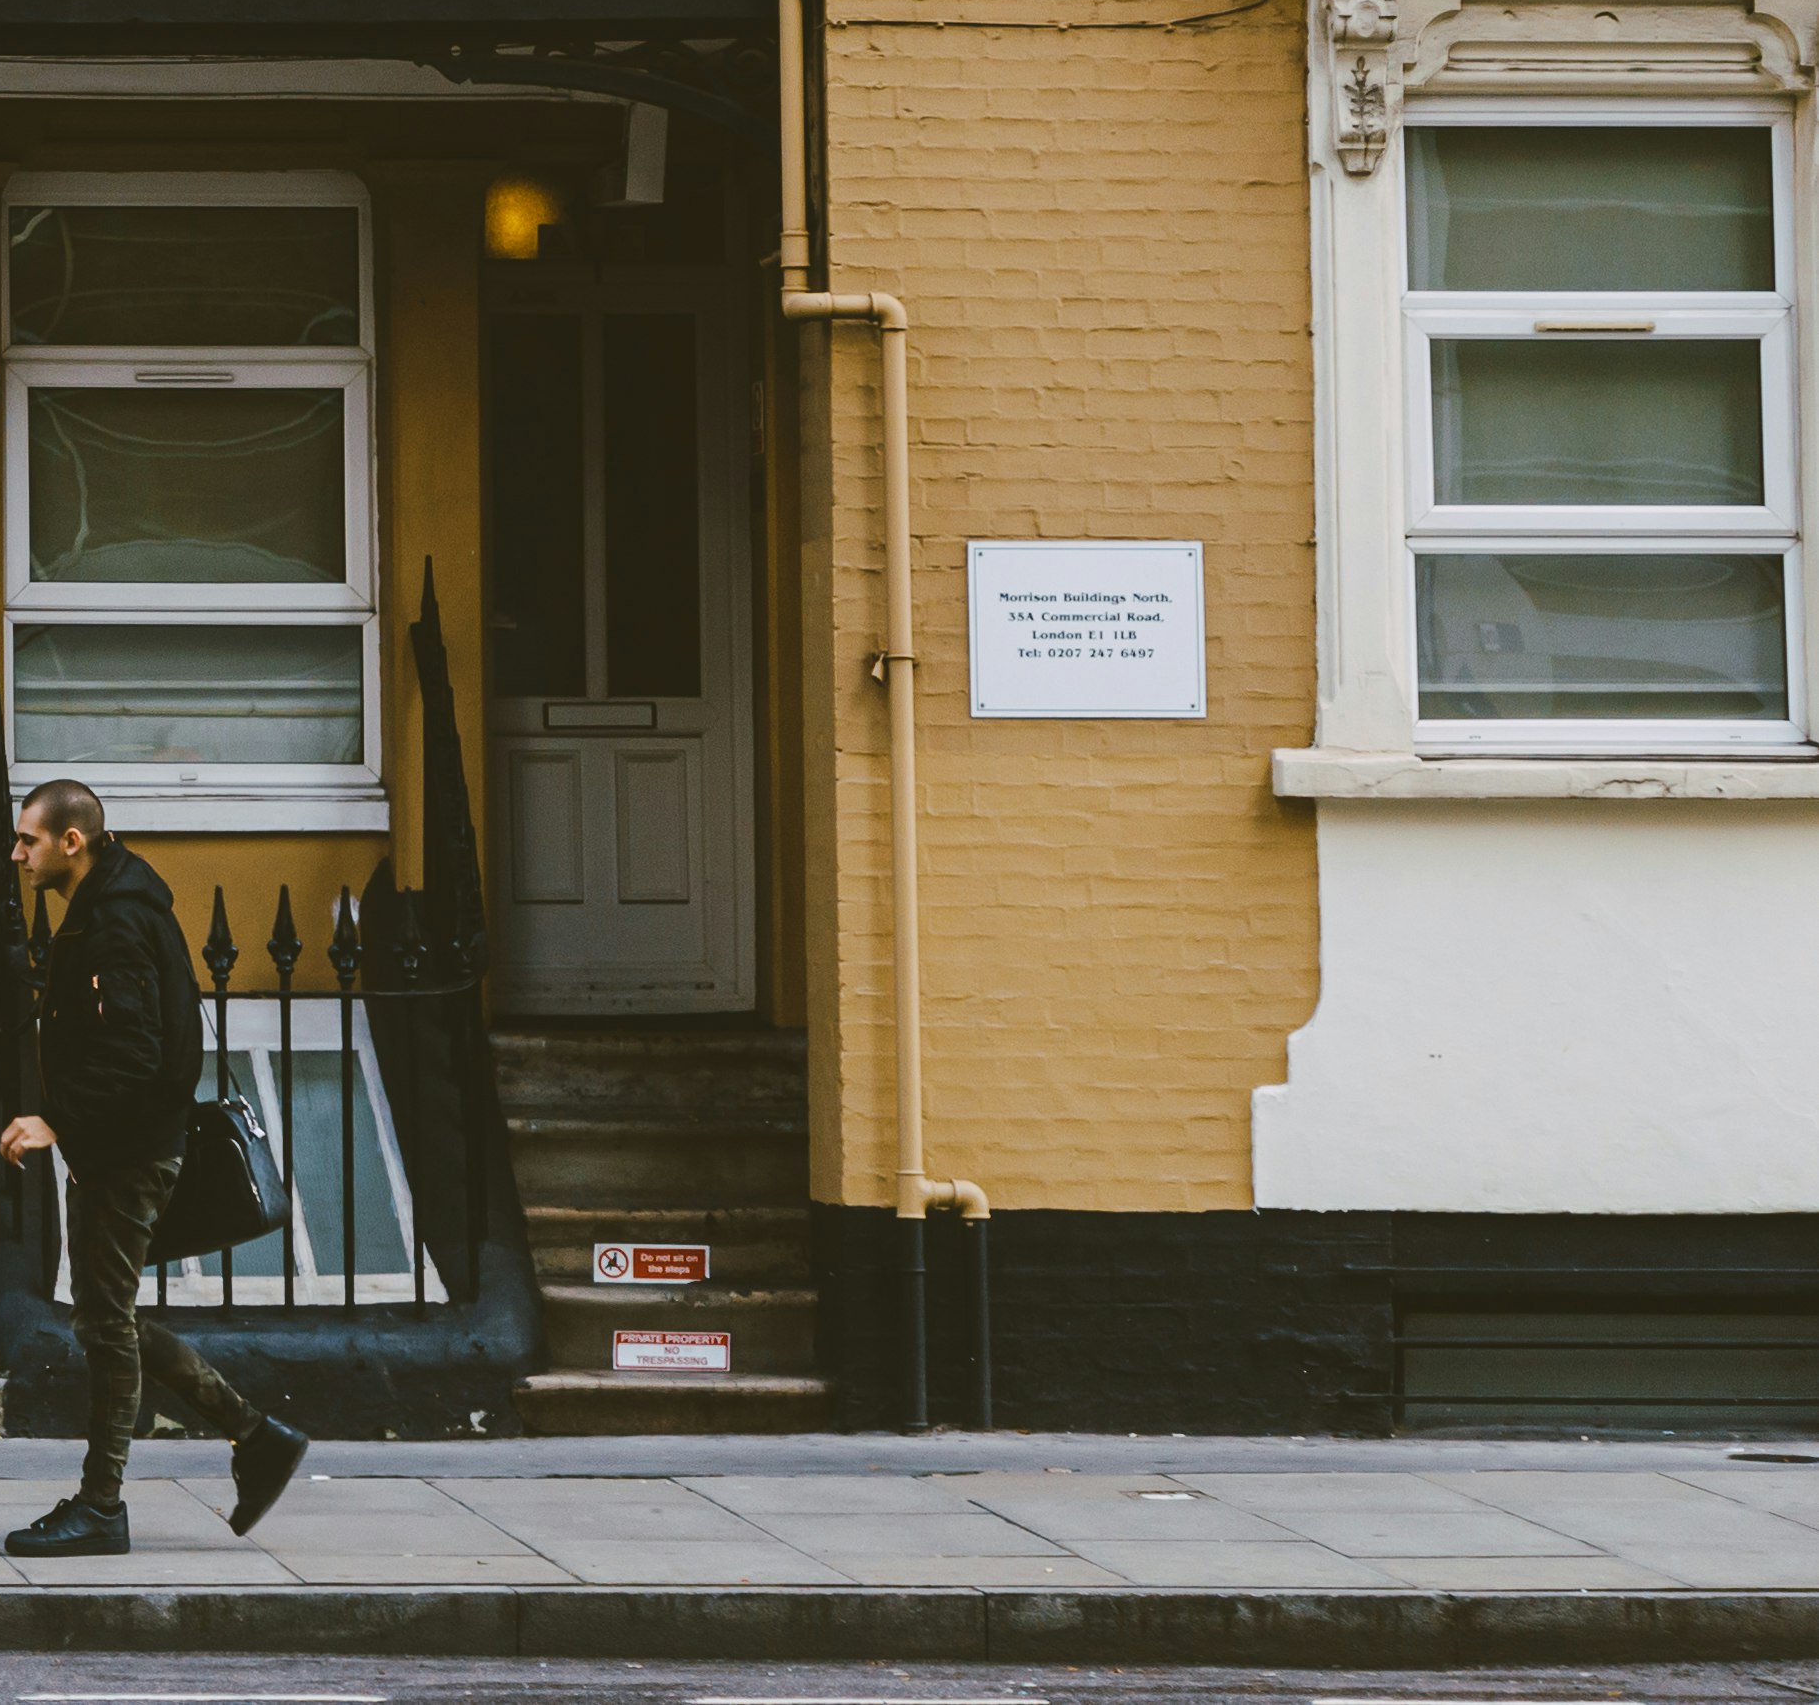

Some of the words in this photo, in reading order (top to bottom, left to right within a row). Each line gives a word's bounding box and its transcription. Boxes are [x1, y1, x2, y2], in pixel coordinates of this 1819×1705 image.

[1000, 593, 1056, 602] Morrison
[1064, 593, 1126, 605] Buildings
[1008, 613, 1034, 621] 35A
[1042, 613, 1120, 621] Commercial
[1033, 631, 1082, 639] London
[1089, 631, 1103, 639] E1
[1114, 631, 1137, 639] 1LB
[1018, 649, 1041, 658] Tel:
[1048, 649, 1081, 658] 0207
[1090, 649, 1113, 658] 247
[1121, 649, 1154, 658] 6497
[641, 1254, 653, 1262] Do
[656, 1254, 670, 1262] not
[673, 1254, 684, 1262] sit
[648, 1265, 662, 1273] the
[665, 1266, 690, 1275] steps
[621, 1334, 662, 1343] PRIVATE
[666, 1334, 723, 1343] PROPERTY
[637, 1356, 708, 1365] TRESPASSING
